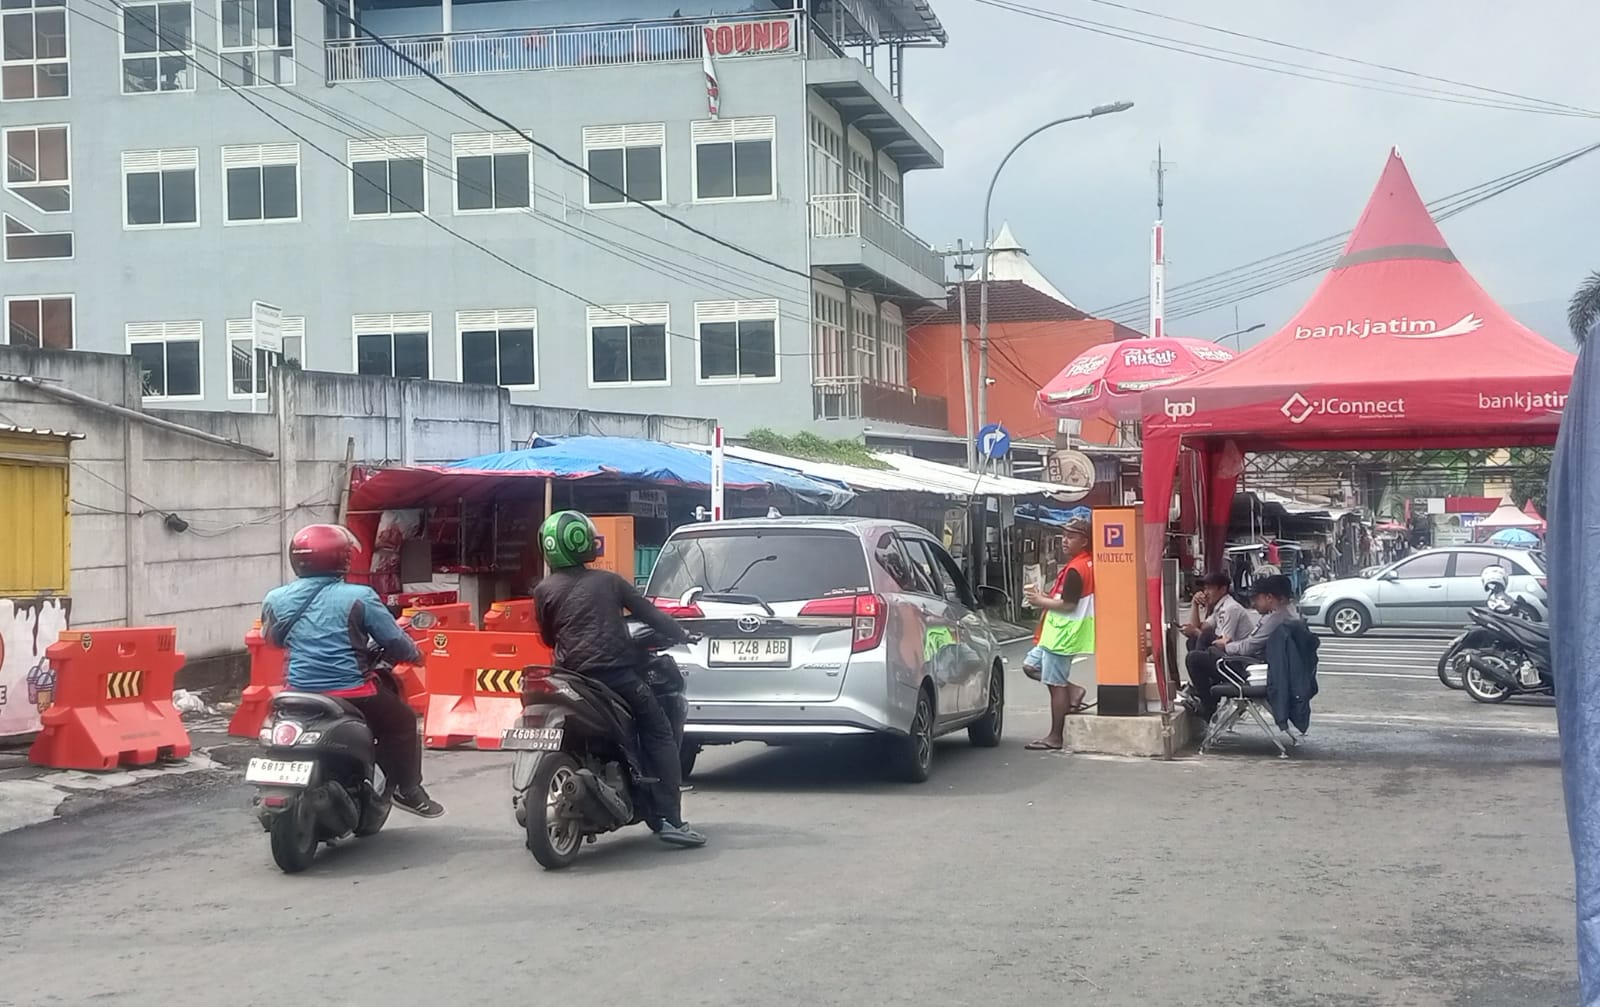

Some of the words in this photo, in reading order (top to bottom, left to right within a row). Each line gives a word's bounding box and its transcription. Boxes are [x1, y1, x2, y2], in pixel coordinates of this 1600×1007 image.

[1295, 317, 1436, 339] bankjatim
[1107, 527, 1120, 545] P
[712, 641, 719, 655] N
[732, 640, 759, 655] 1248
[765, 641, 786, 654] ABB
